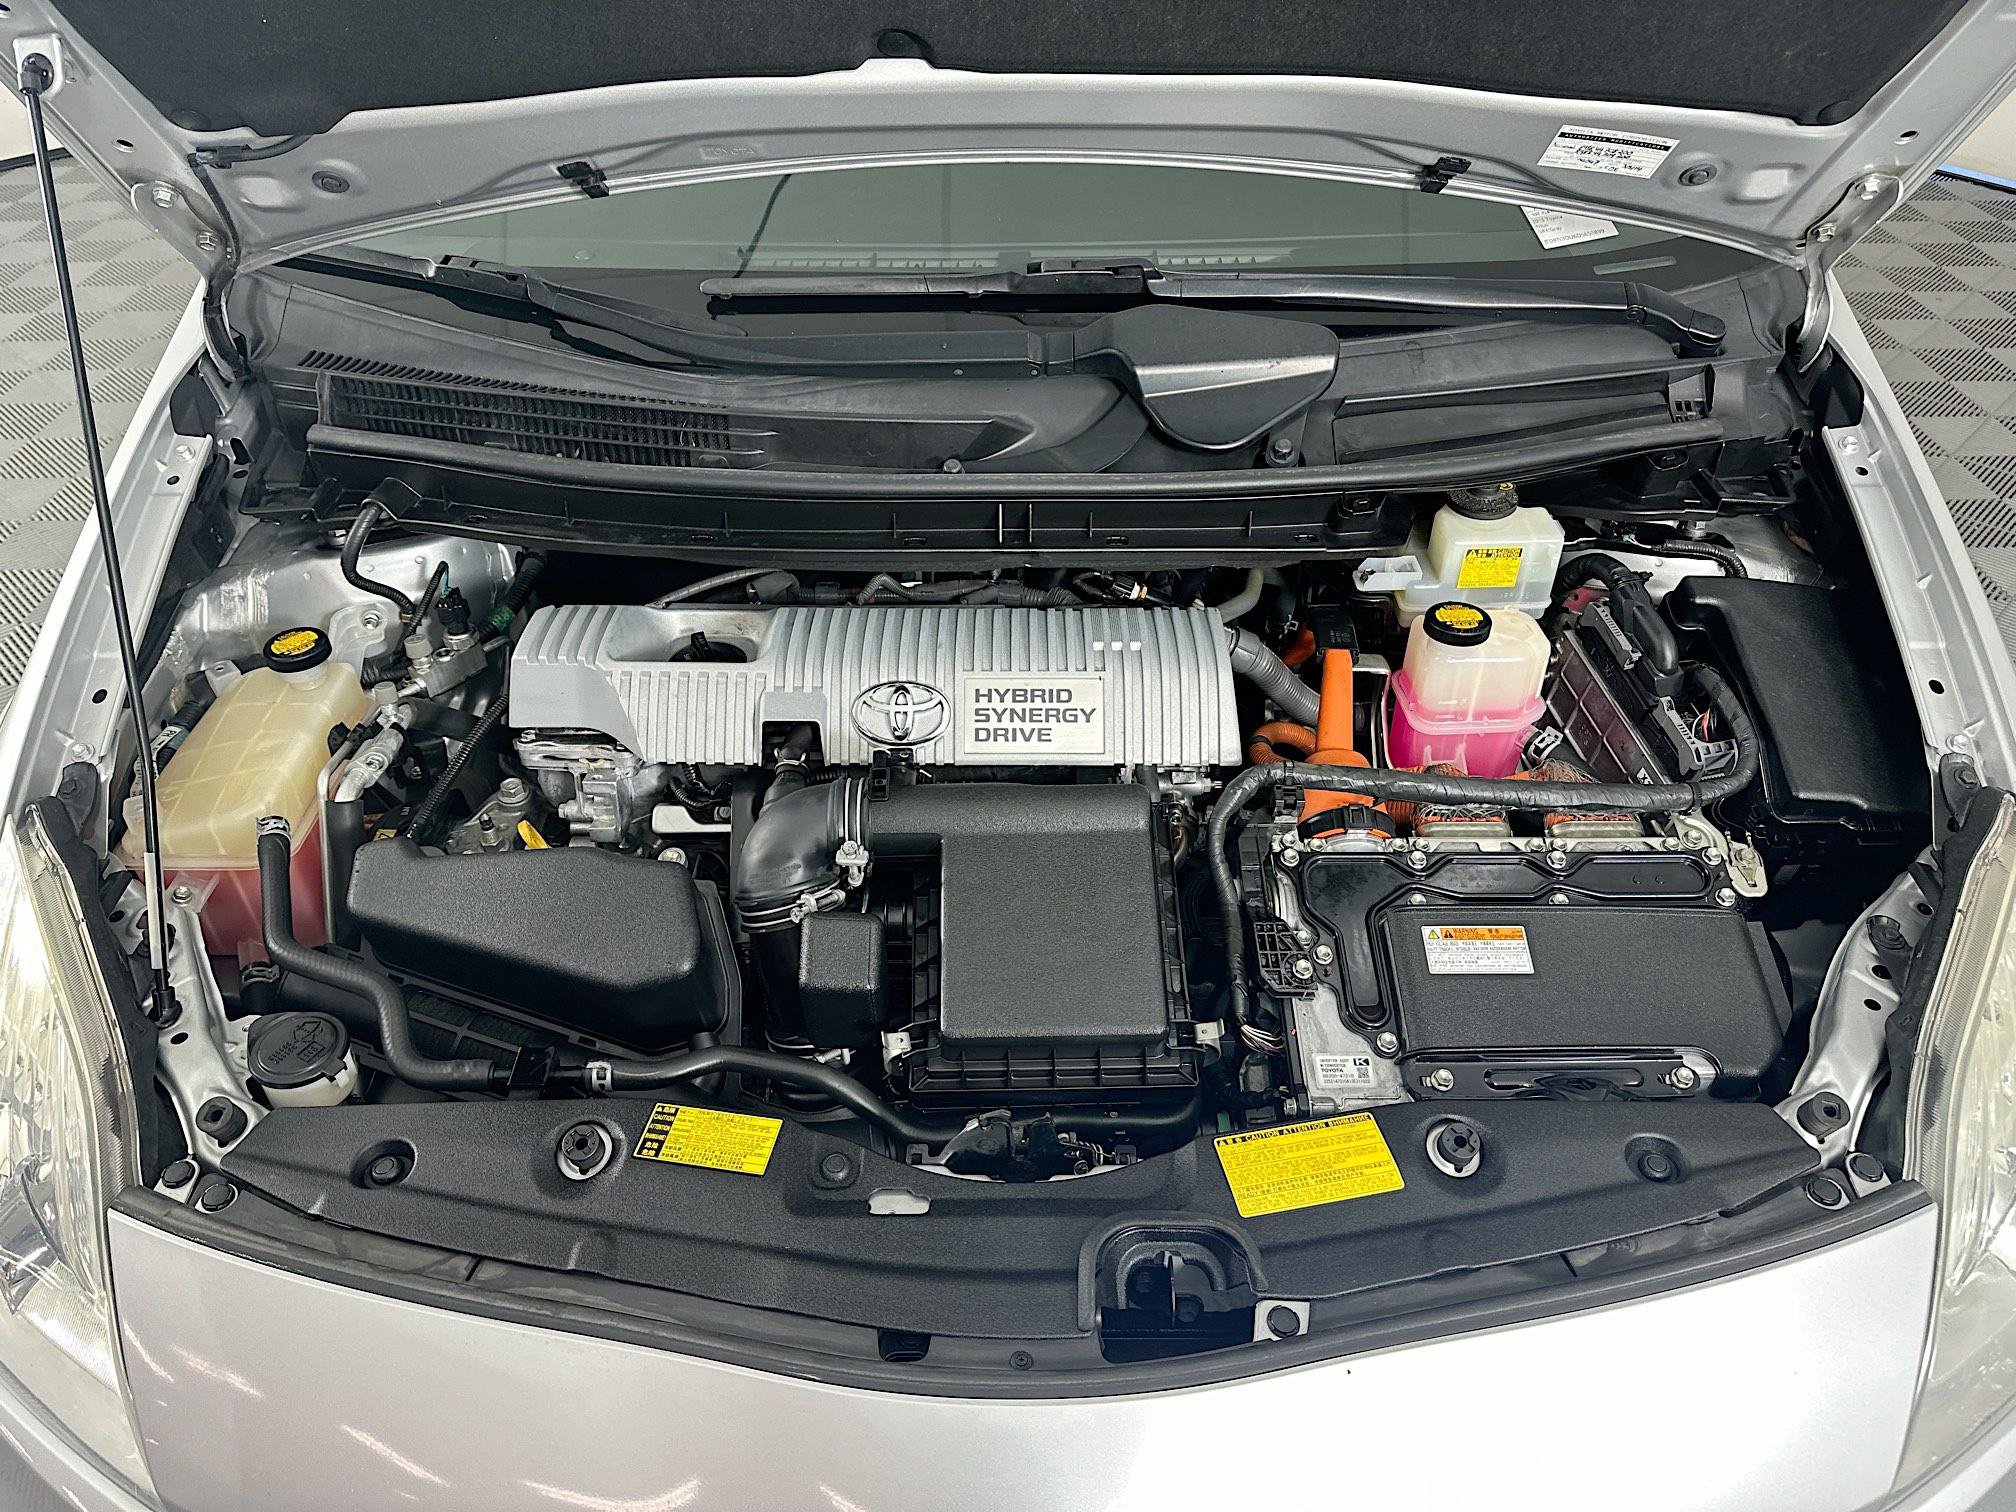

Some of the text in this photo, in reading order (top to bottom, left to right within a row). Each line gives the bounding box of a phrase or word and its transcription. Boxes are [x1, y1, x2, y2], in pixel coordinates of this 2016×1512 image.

[1564, 133, 1666, 150] AUTHORIZED MODIFICATIONS
[975, 689, 1073, 703] HYBRID
[974, 708, 1096, 722] SYNERGY
[974, 728, 1052, 742] DRIVE
[653, 1114, 675, 1122] CAUTION
[648, 1123, 671, 1131] ATTENTION
[1245, 1130, 1279, 1141] CAUTION
[1283, 1122, 1325, 1136] ATTENTION
[1328, 1115, 1370, 1128] ВНИМАНИЕ
